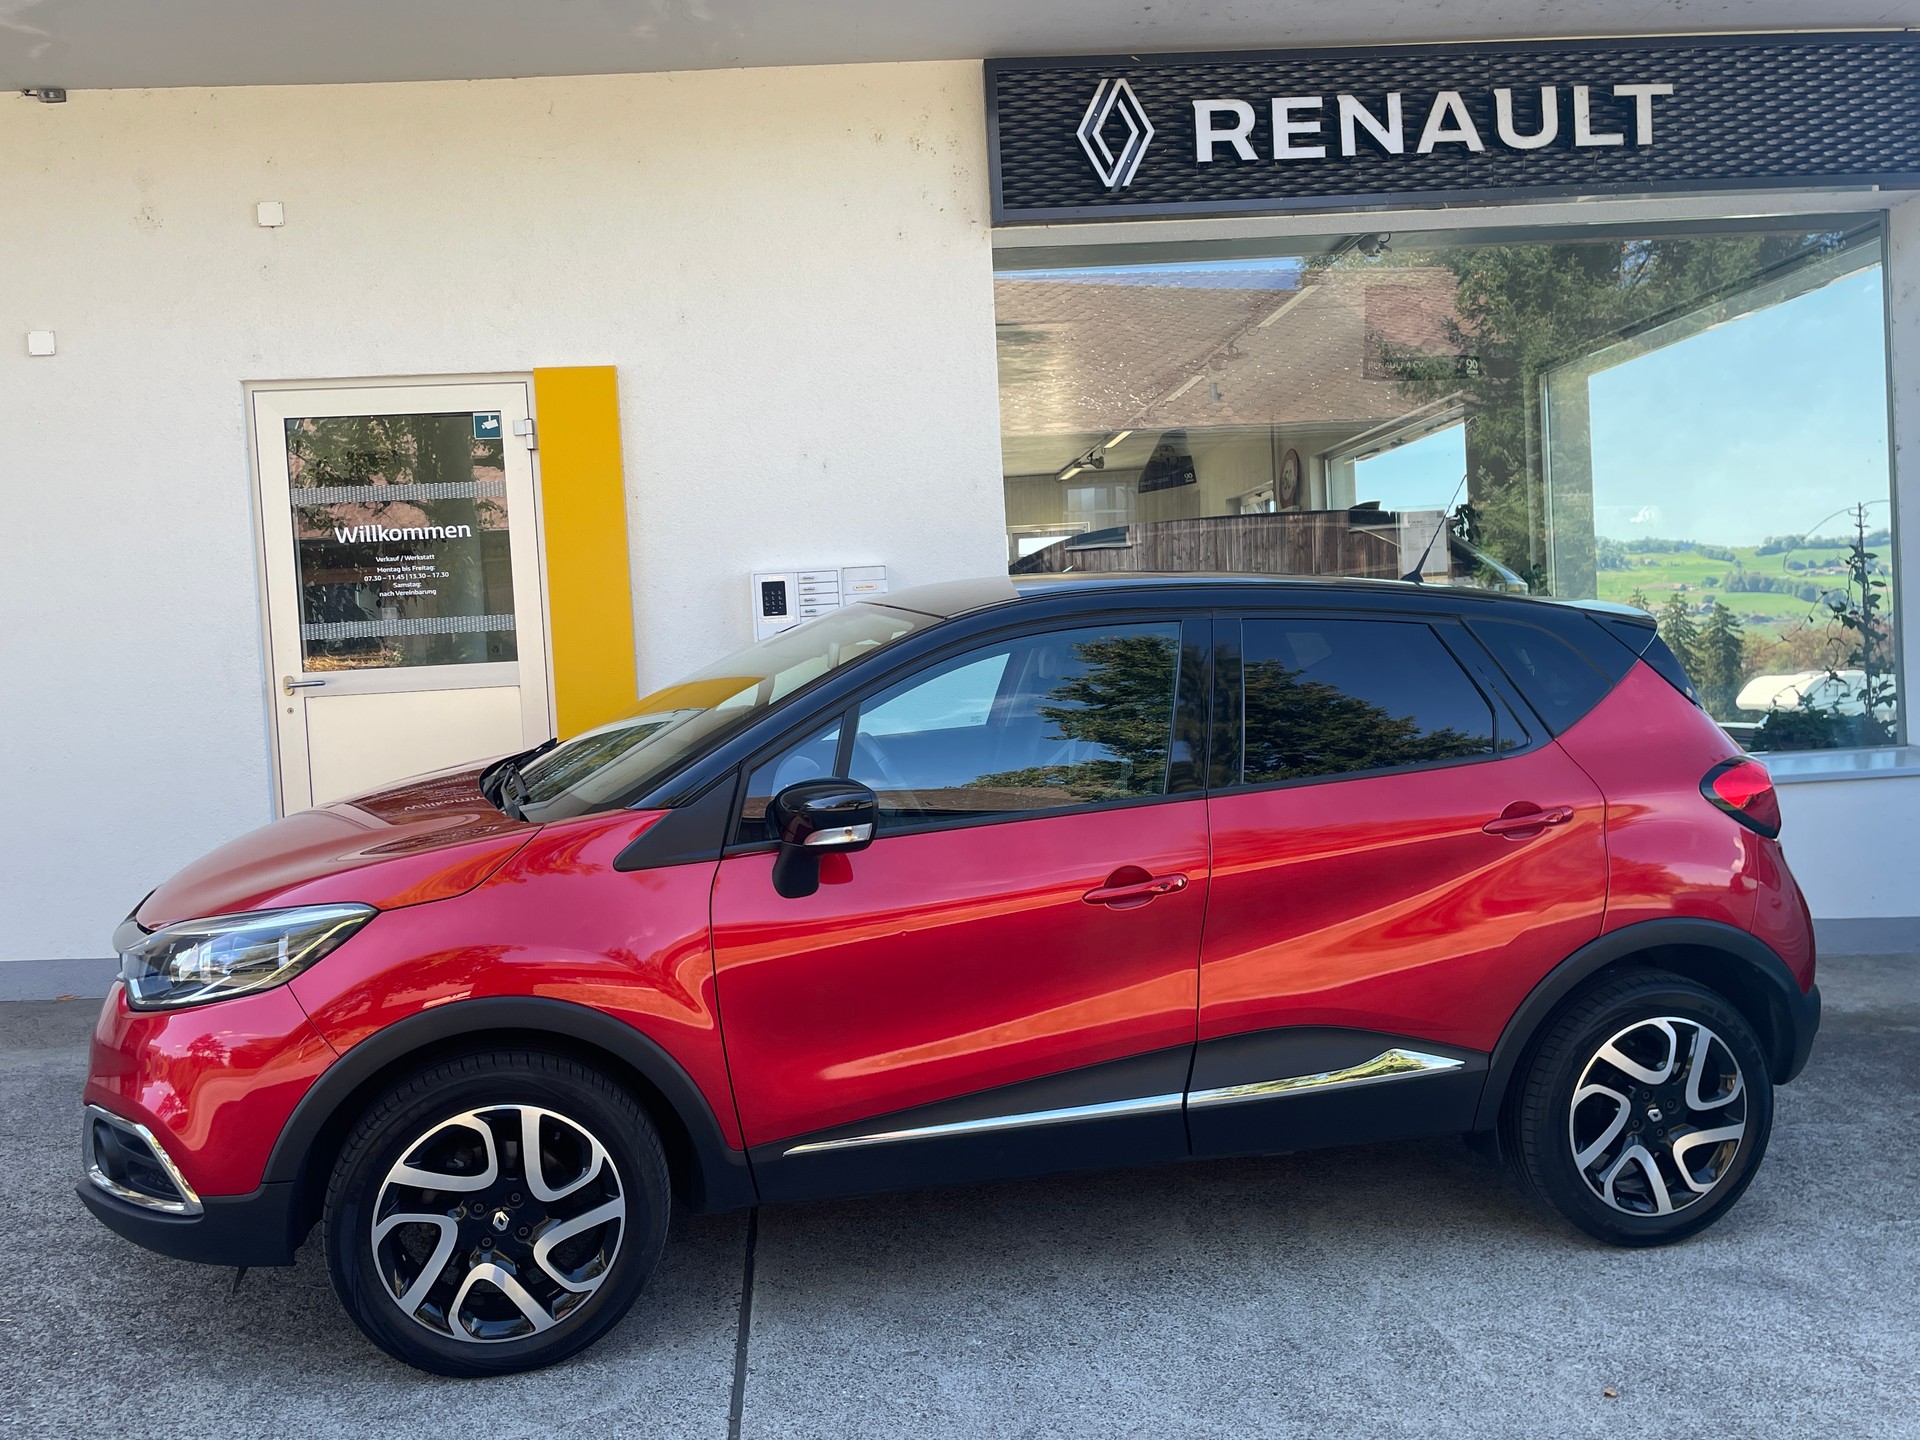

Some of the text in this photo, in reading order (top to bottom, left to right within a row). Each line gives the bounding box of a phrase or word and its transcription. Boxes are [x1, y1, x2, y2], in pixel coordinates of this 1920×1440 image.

[1193, 82, 1674, 163] RENAULT
[1466, 358, 1478, 370] 90
[334, 524, 472, 544] Willkommen
[375, 555, 400, 563] Verkauf
[377, 566, 401, 574] Montag
[395, 589, 437, 597] Vereinbarung
